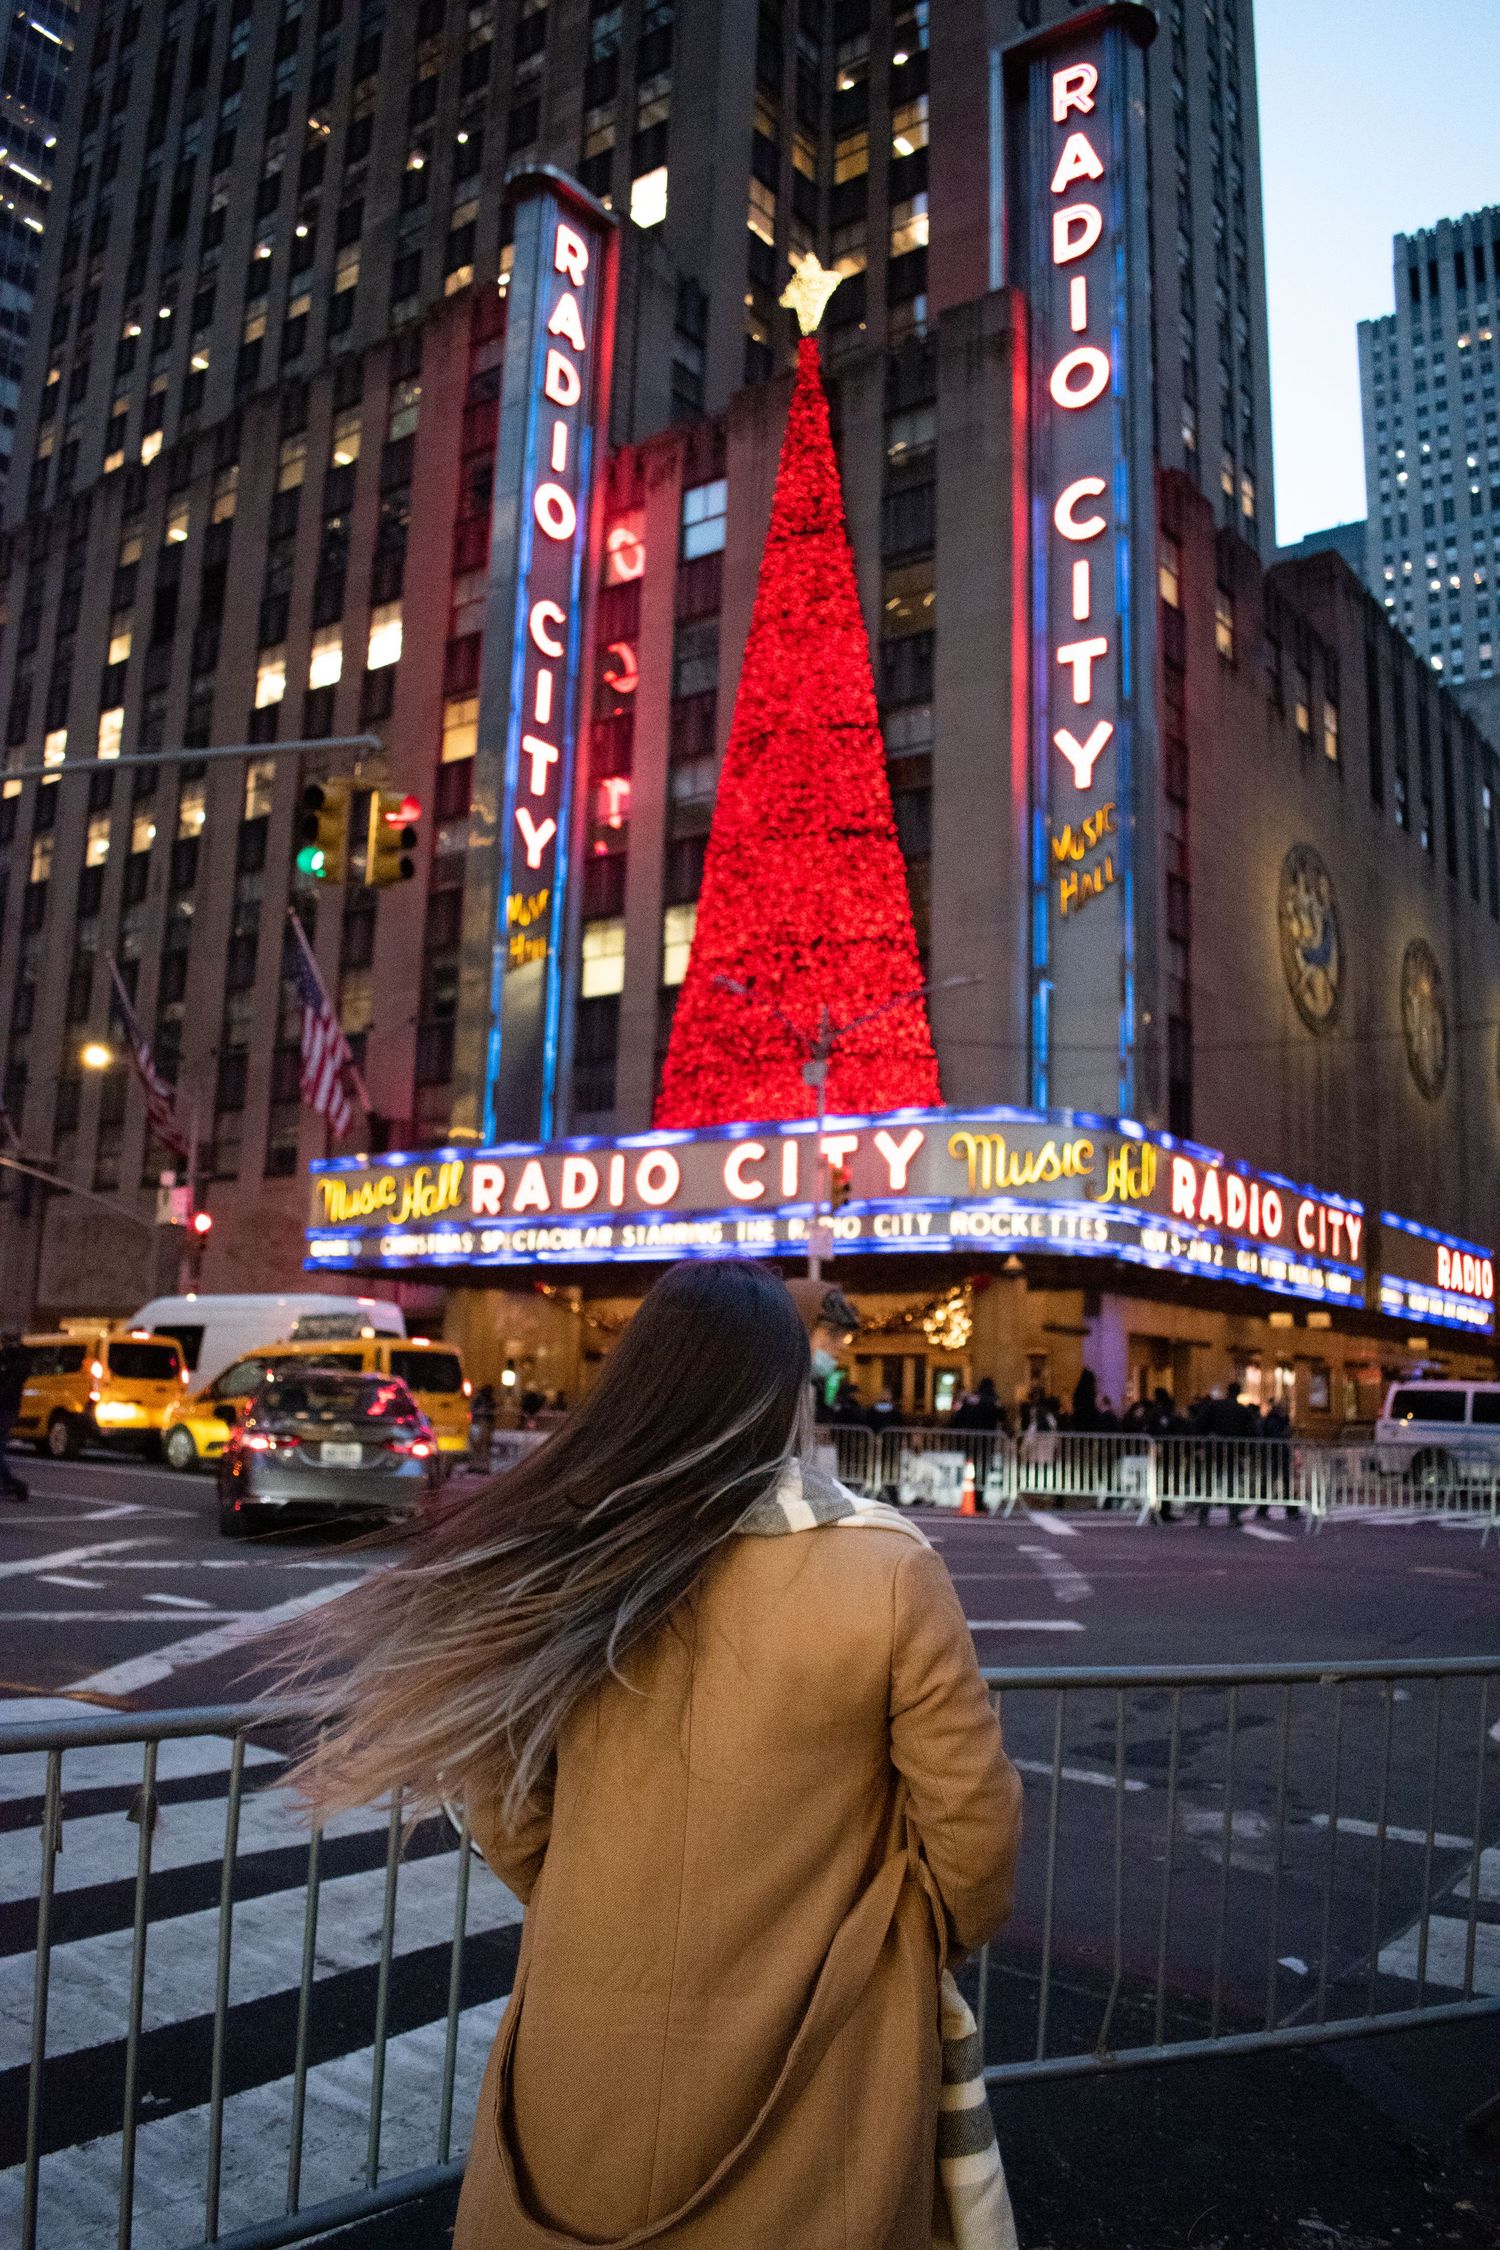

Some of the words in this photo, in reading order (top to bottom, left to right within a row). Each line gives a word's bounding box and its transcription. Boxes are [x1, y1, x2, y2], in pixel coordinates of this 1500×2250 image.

[1050, 63, 1110, 409] RADIO
[533, 224, 589, 540] RADIO
[1053, 477, 1113, 789] CITY
[515, 600, 566, 868] CITY
[471, 1149, 680, 1215] RADIO
[723, 1128, 925, 1201] CITY
[947, 1131, 1096, 1198] Music
[873, 1213, 933, 1236] CITY
[949, 1210, 1109, 1243] ROCKETTES
[1172, 1157, 1283, 1239] RADIO
[1297, 1200, 1361, 1261] CITY
[1437, 1246, 1493, 1299] RADIO
